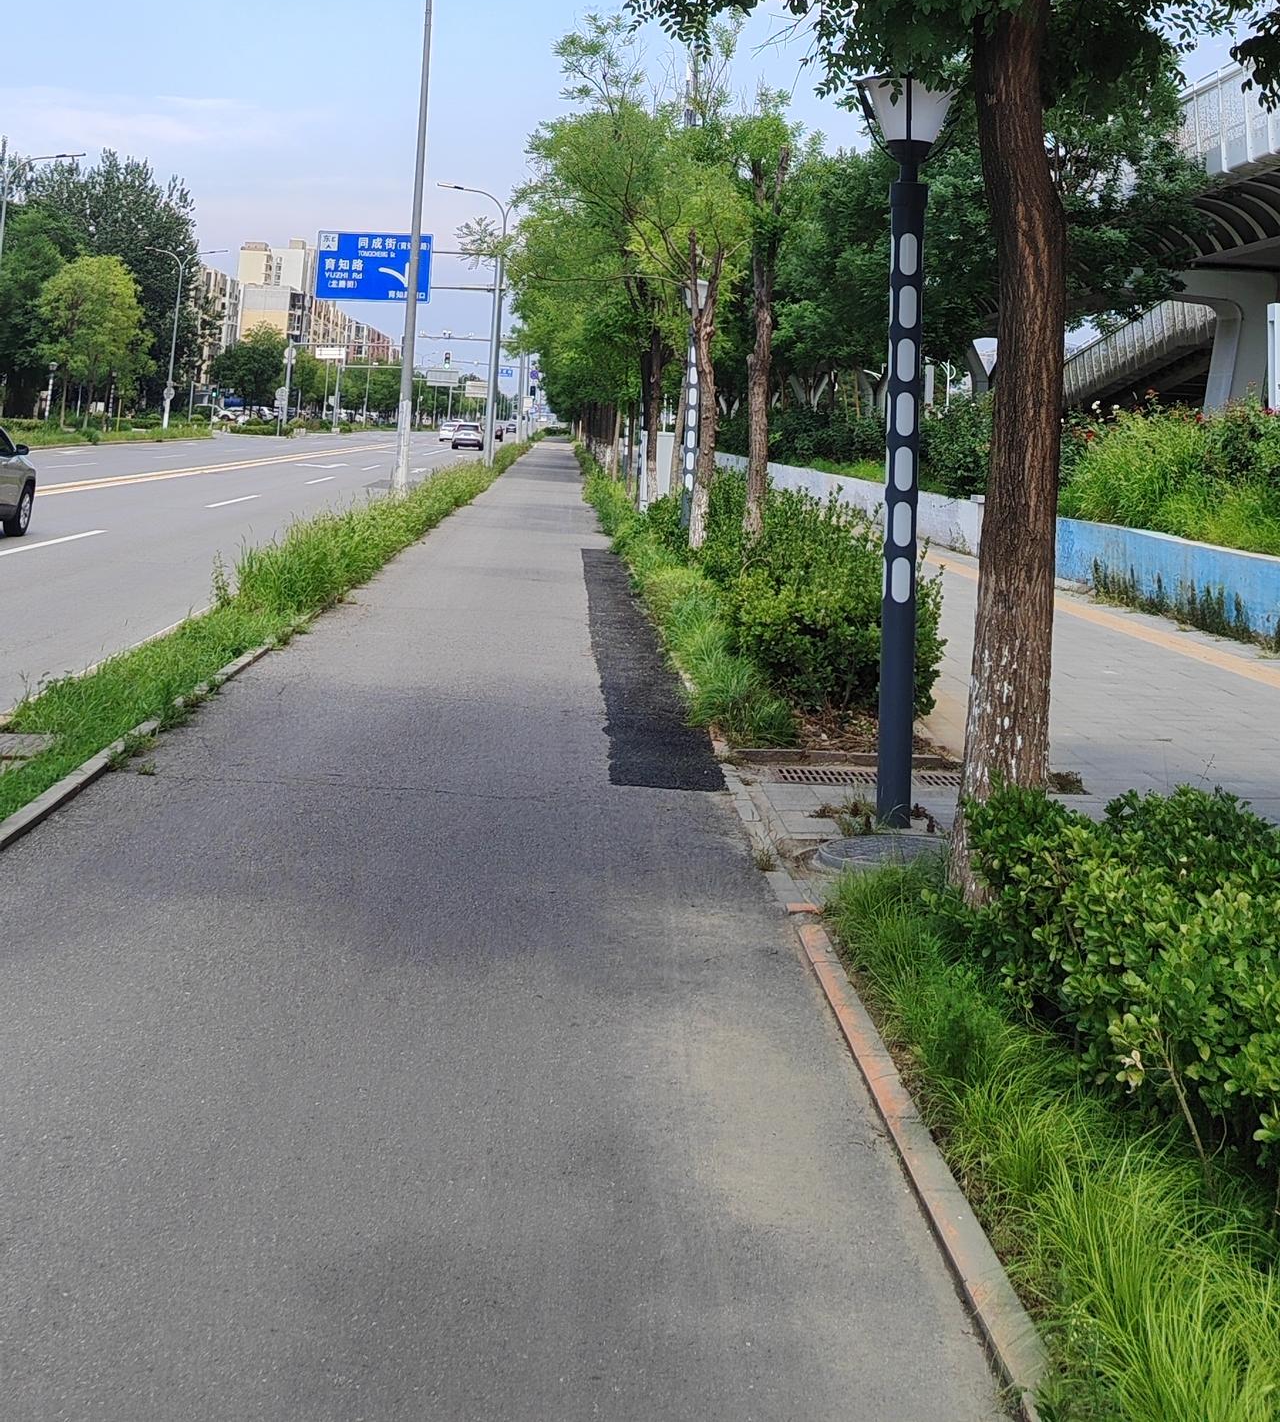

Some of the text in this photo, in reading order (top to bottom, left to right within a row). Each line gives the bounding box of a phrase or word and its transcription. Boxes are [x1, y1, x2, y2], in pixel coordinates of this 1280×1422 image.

[358, 237, 396, 250] 同成街
[325, 258, 364, 271] 育知路
[325, 271, 349, 279] YUZHI
